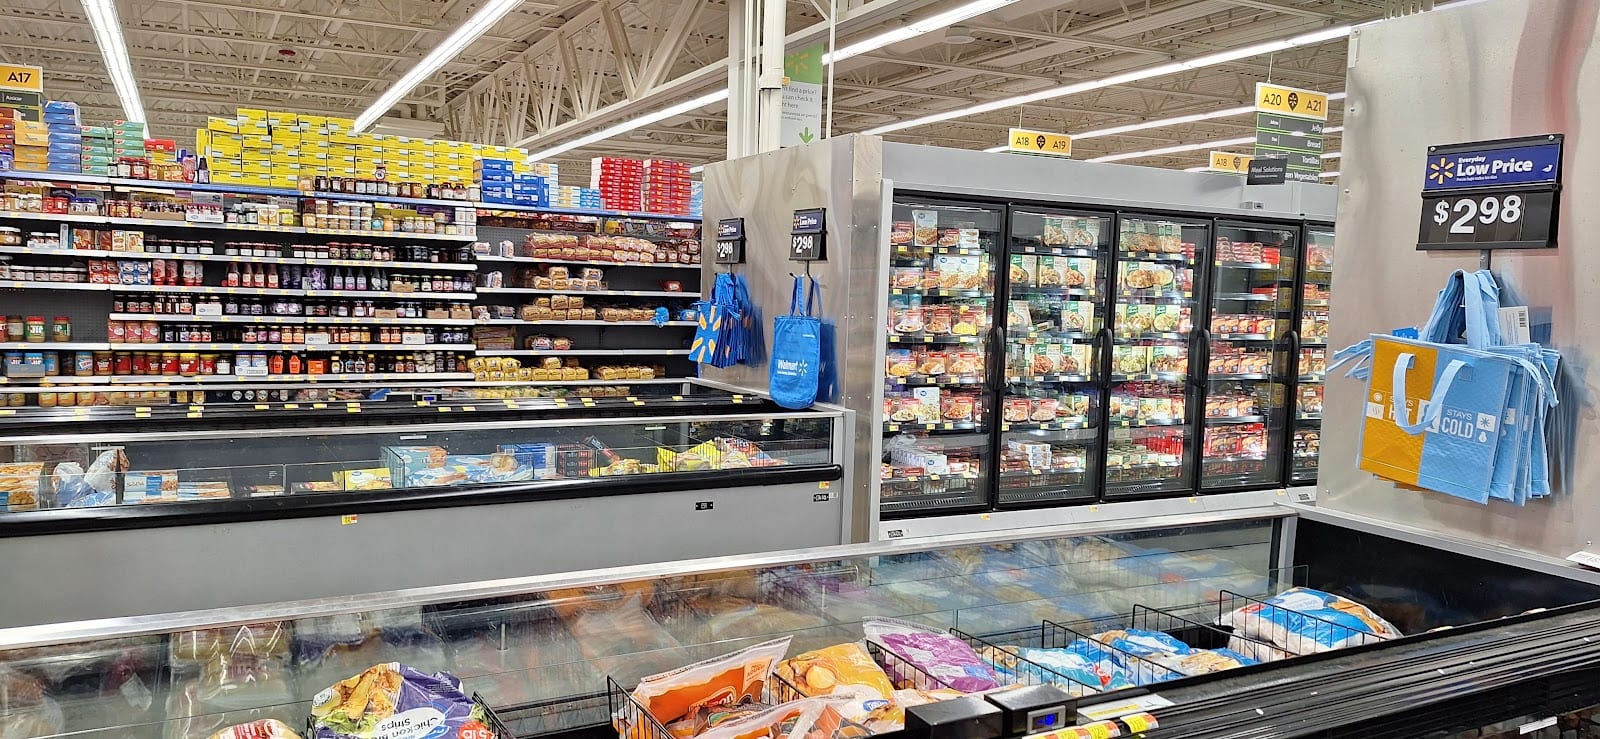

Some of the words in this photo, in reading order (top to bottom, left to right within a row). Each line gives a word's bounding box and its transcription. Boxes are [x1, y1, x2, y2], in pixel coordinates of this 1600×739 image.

[8, 72, 31, 83] A17
[1263, 93, 1281, 106] A20
[1306, 100, 1322, 112] A21
[1016, 137, 1029, 146] A18
[1053, 140, 1066, 150] A19
[1307, 140, 1321, 148] Bread
[1216, 158, 1227, 167] A18
[1456, 164, 1490, 177] Low
[1491, 158, 1533, 174] Price
[777, 359, 798, 371] Walmart
[1446, 409, 1473, 421] STAYS
[1441, 417, 1474, 439] COLD
[381, 718, 411, 731] Strips
